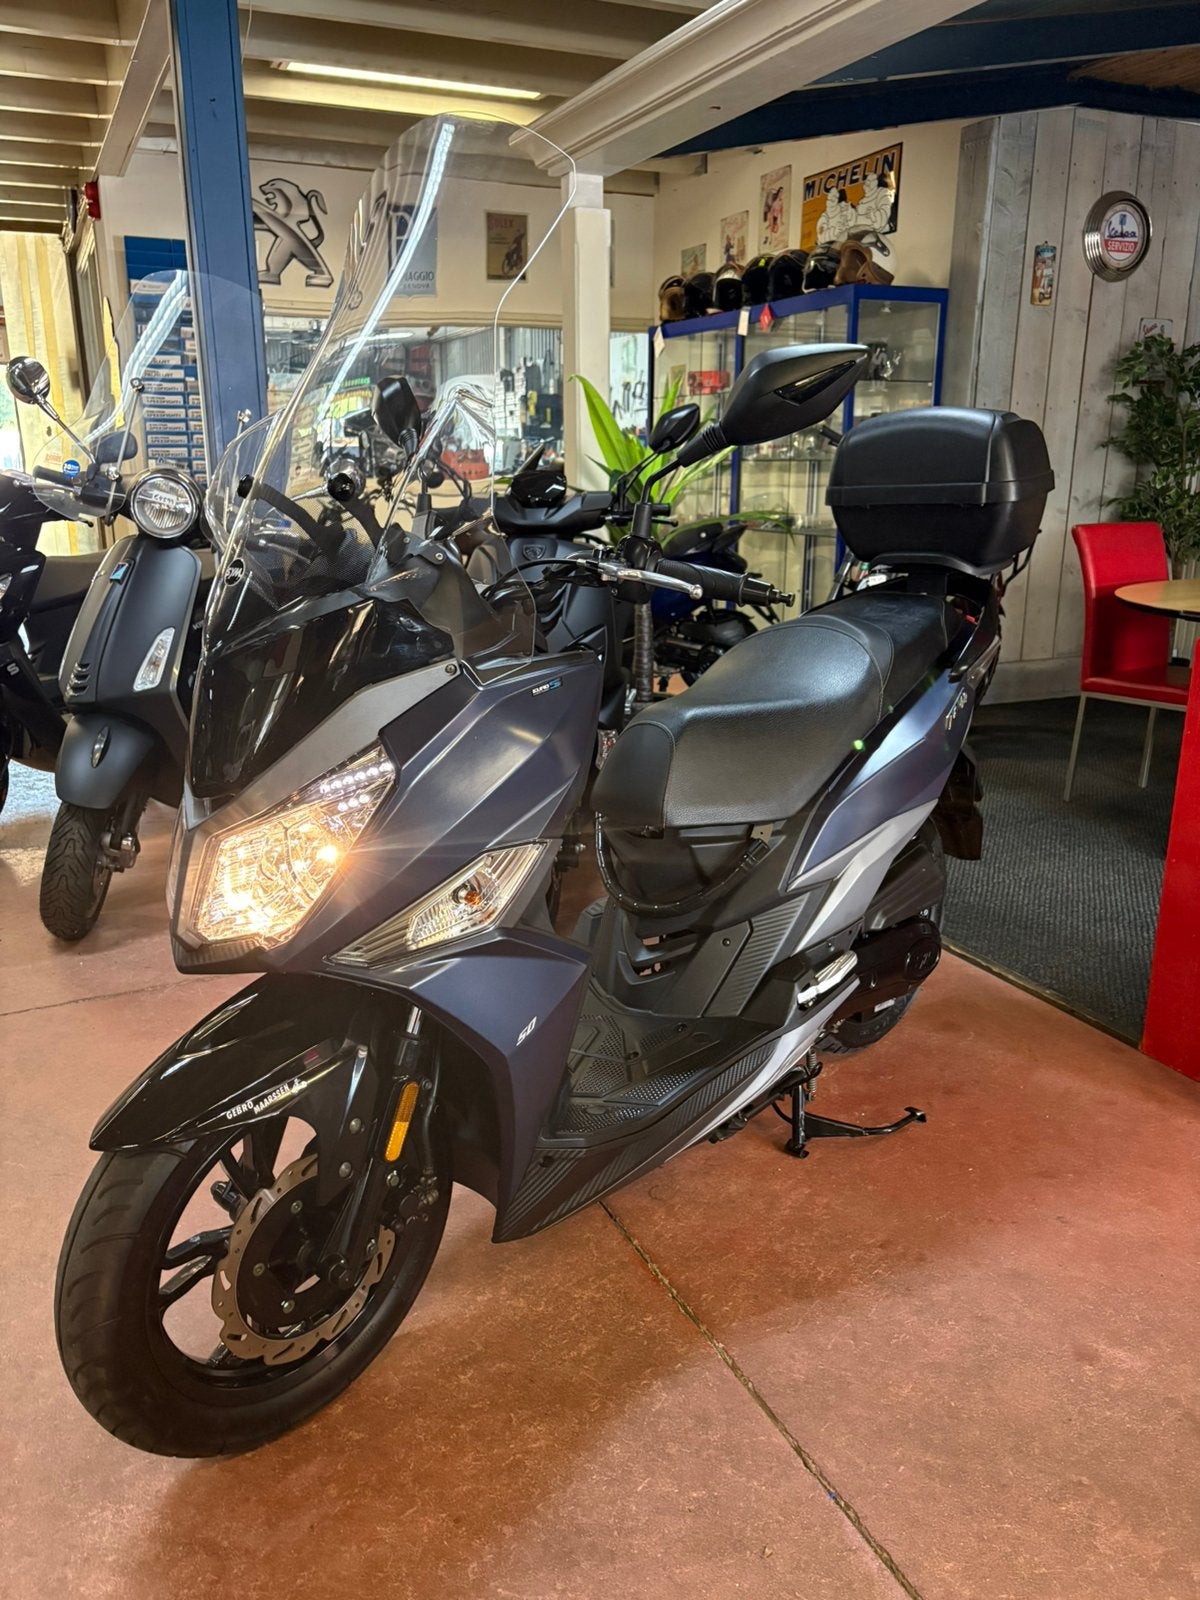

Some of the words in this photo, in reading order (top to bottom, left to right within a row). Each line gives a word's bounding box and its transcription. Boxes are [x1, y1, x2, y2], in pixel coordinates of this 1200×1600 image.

[804, 151, 895, 201] MICHELIN
[1107, 240, 1135, 251] SERVIZIO
[516, 1015, 537, 1046] 50
[226, 1100, 254, 1120] GEBRO
[253, 1083, 290, 1114] MAARSSEN
